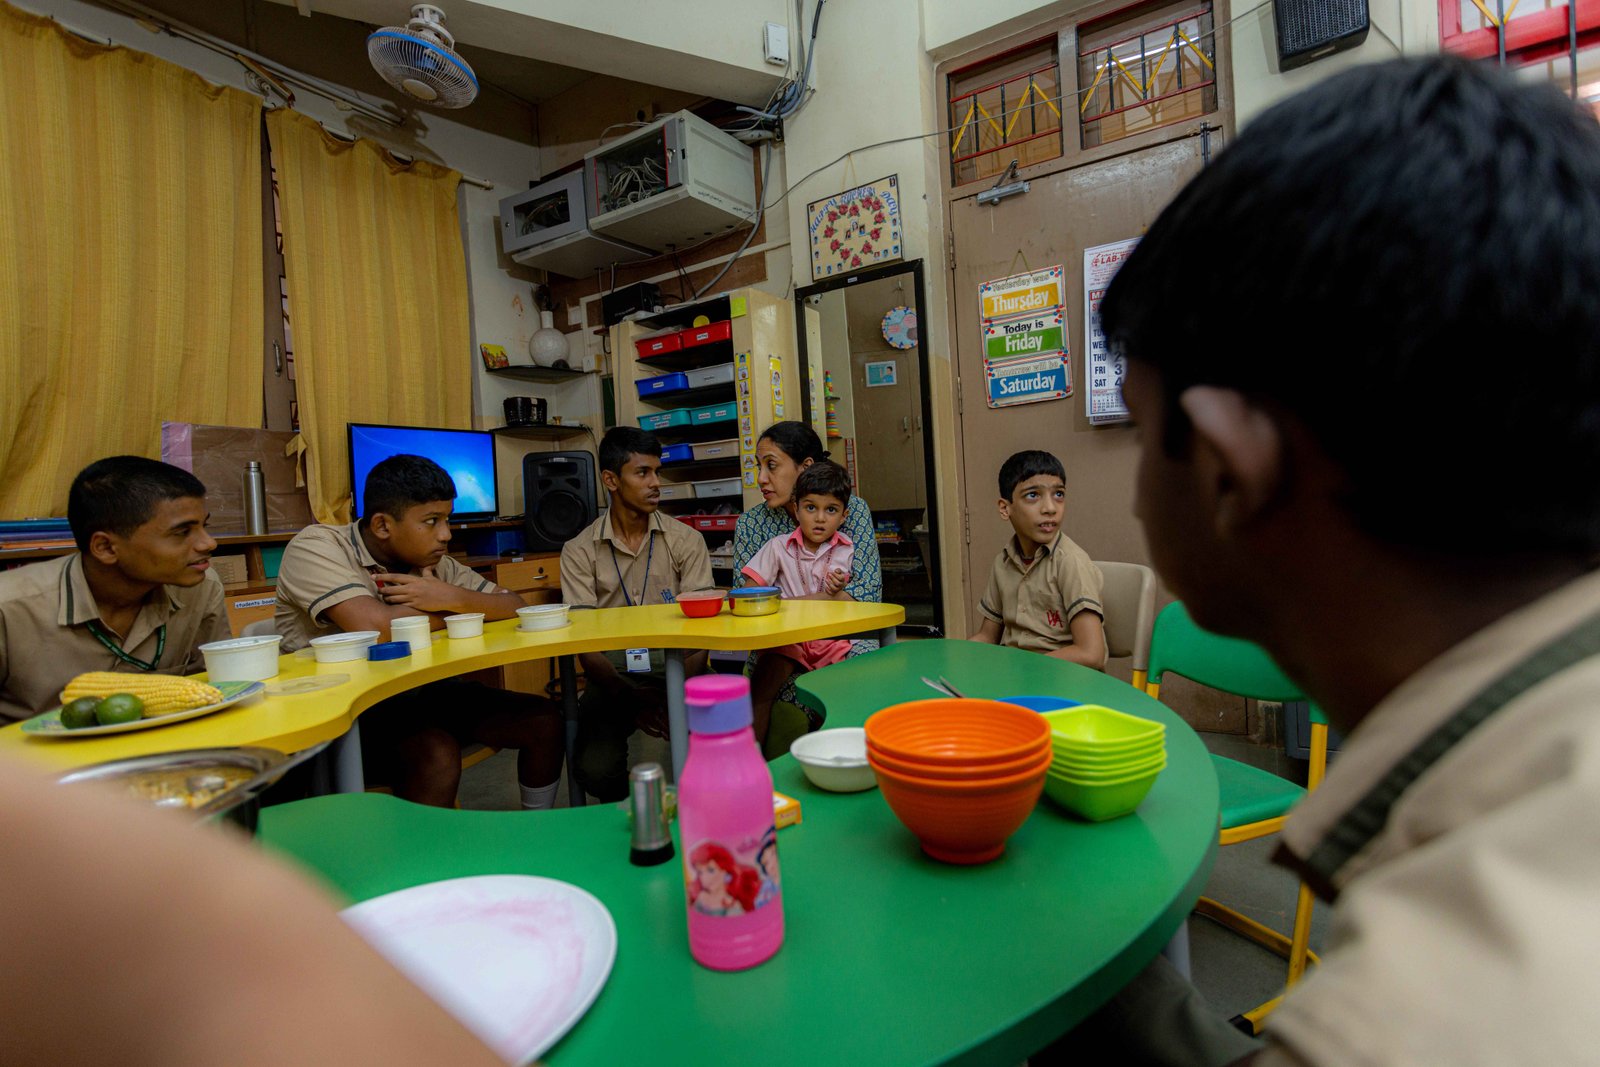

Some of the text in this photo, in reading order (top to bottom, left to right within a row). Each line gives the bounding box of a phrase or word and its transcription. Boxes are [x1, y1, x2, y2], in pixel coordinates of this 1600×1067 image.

[991, 285, 1050, 314] Thursday
[1003, 319, 1044, 335] Today is
[1005, 333, 1043, 353] Friday
[1093, 353, 1107, 362] THU
[1094, 363, 1123, 376] FRI 3
[999, 373, 1057, 395] Saturday
[1094, 378, 1107, 388] SAT
